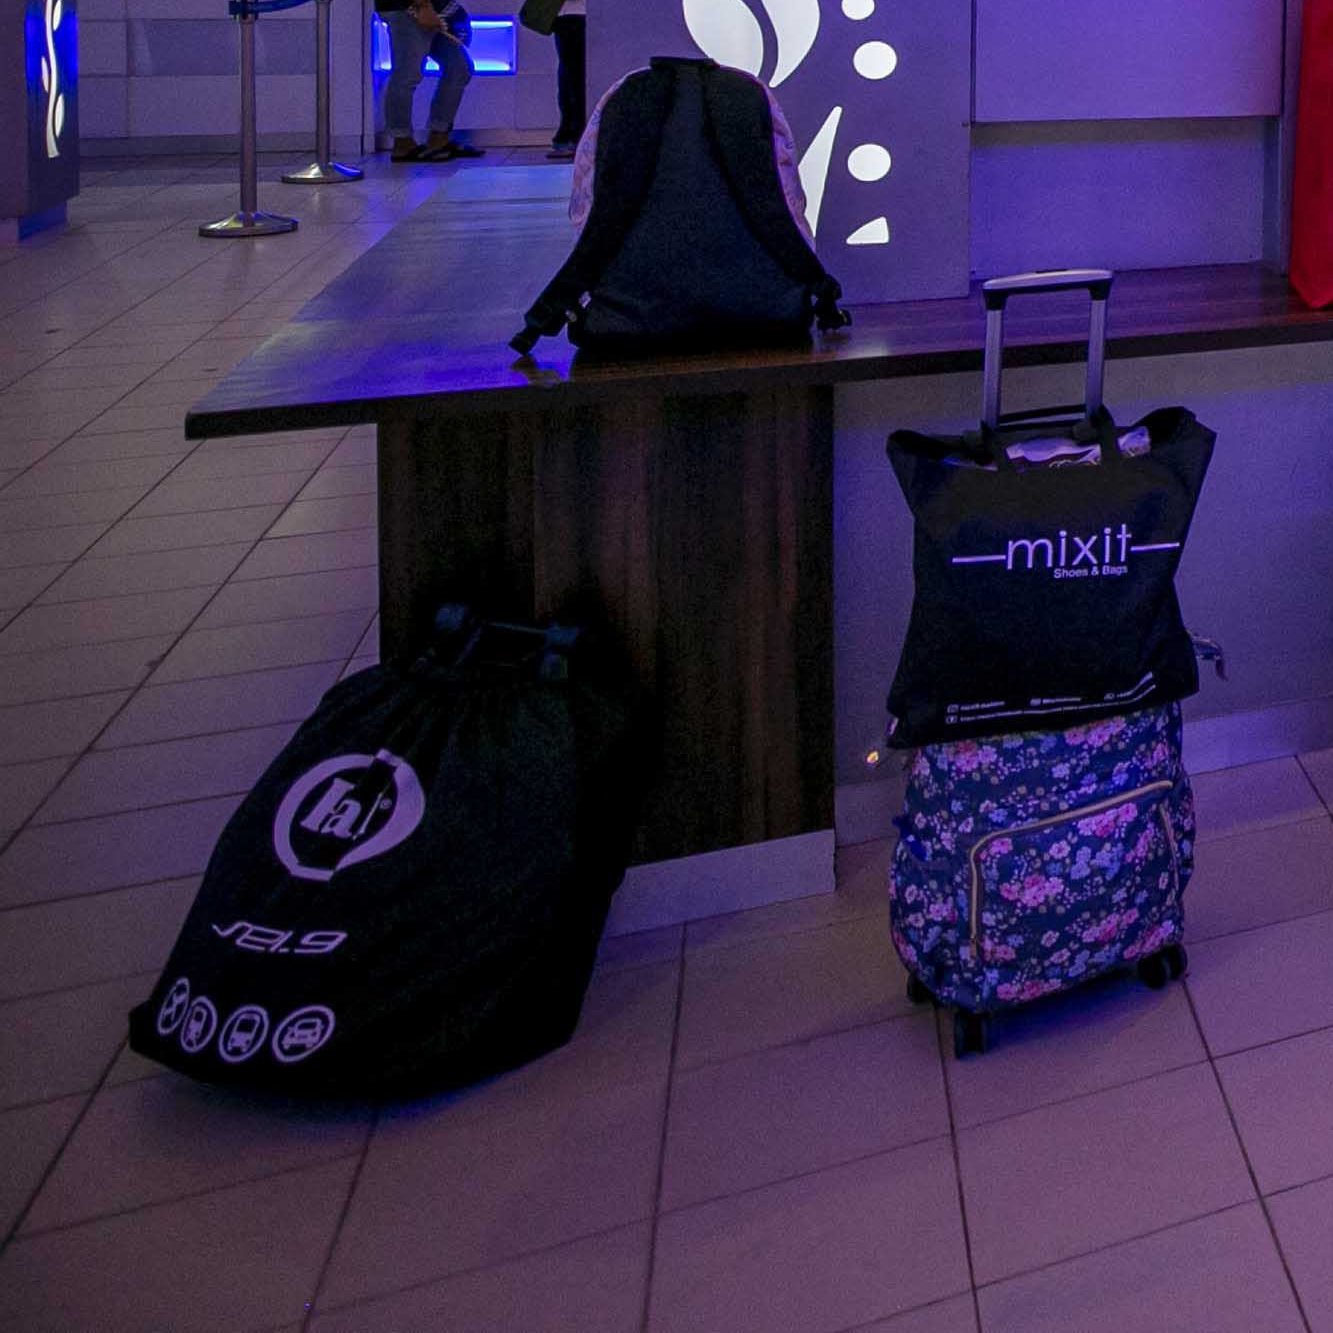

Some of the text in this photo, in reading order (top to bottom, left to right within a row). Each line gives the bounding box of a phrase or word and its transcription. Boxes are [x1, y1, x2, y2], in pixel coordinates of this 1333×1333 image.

[1006, 523, 1132, 570] mixit
[1053, 564, 1128, 579] Shoes & Bags
